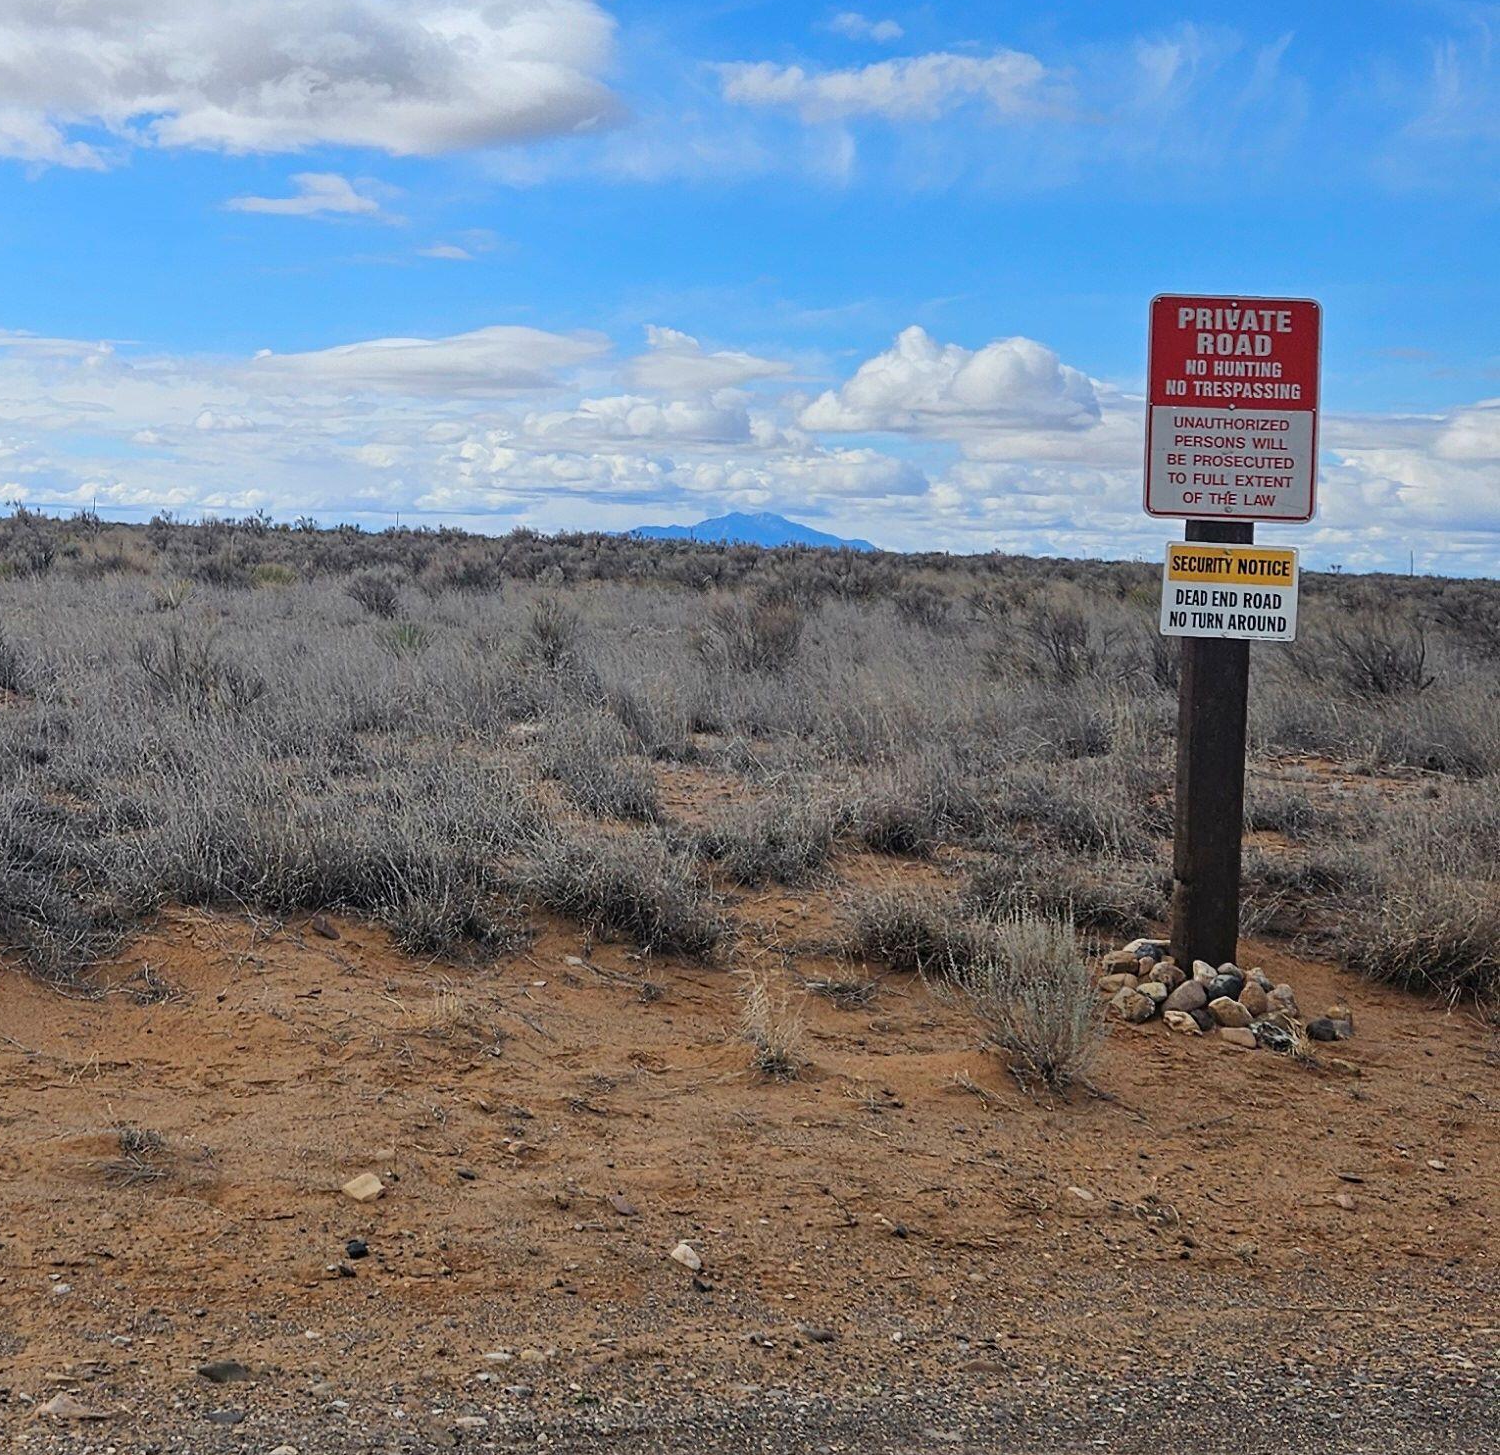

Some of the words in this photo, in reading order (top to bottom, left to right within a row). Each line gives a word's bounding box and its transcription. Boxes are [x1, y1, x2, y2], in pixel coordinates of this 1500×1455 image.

[1178, 307, 1292, 332] PRIVATE
[1197, 333, 1272, 356] ROAD
[1186, 360, 1207, 375] NO
[1214, 361, 1281, 377] HUNTING
[1166, 380, 1186, 395] NO
[1194, 381, 1300, 399] TRESPASSING
[1174, 417, 1289, 431] UNAUTHORIZED
[1175, 435, 1245, 448] PERSONS
[1253, 438, 1287, 450] WILL
[1167, 454, 1185, 465] BE
[1193, 455, 1294, 469] PROSECUTED
[1168, 473, 1186, 484] TO
[1194, 474, 1228, 485] FULL
[1235, 475, 1293, 487] EXTENT
[1183, 492, 1202, 503] OF
[1209, 493, 1237, 505] THE
[1244, 495, 1276, 506] LAW
[1172, 556, 1233, 574] SECURITY
[1238, 559, 1290, 576] NOTICE
[1176, 589, 1207, 606] DEAD
[1212, 591, 1237, 607] END
[1243, 593, 1281, 609] ROAD
[1169, 611, 1186, 627] NO
[1191, 612, 1223, 629] TURN
[1228, 615, 1286, 632] AROUND
